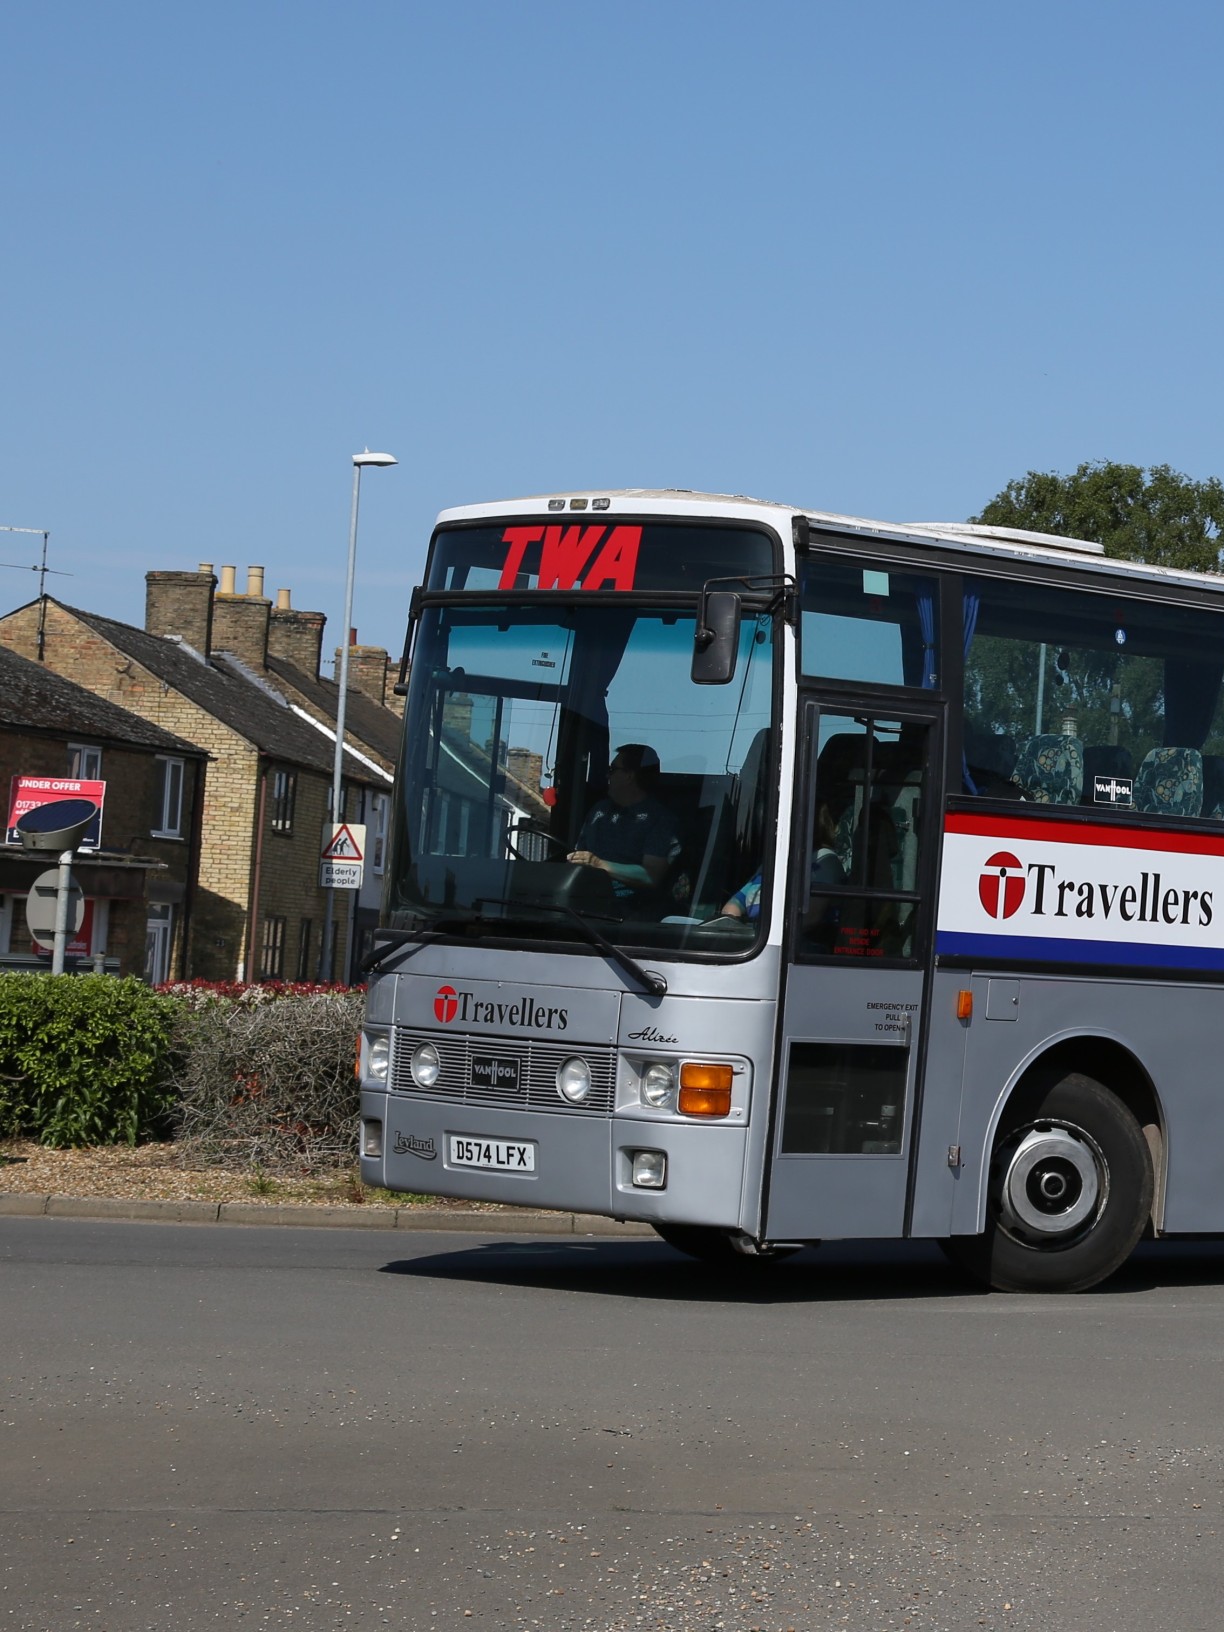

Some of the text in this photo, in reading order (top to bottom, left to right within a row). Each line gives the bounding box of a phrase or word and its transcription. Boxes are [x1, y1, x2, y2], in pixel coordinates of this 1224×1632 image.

[497, 525, 643, 591] TWA
[19, 779, 81, 791] UNDER OFFER
[325, 866, 357, 877] Elderly
[325, 877, 356, 885] people
[1027, 863, 1213, 926] Travellers
[459, 992, 568, 1030] Travellers
[866, 1002, 919, 1011] EMERGENCY EXIT
[885, 1013, 901, 1022] PULL
[874, 1023, 901, 1032] TO OPEN
[394, 1131, 436, 1157] Leyland
[456, 1140, 527, 1166] D574 LFX
